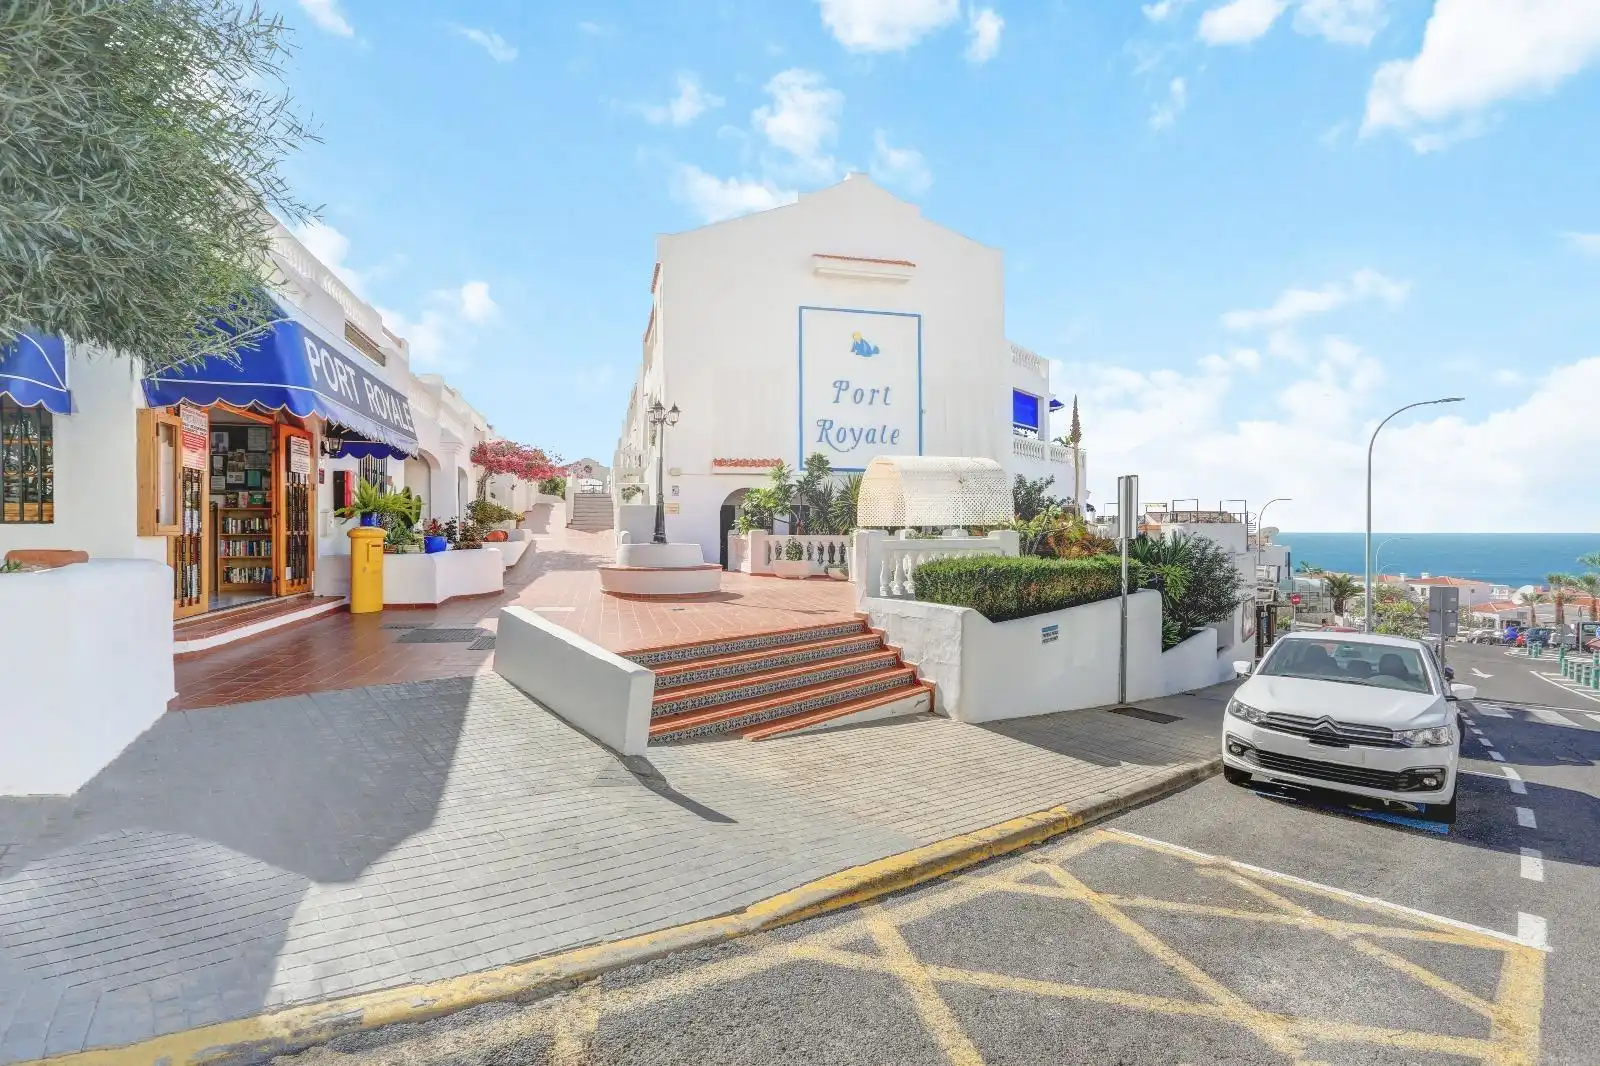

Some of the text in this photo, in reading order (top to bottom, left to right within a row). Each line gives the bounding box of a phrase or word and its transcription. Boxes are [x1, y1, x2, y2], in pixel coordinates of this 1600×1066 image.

[303, 336, 415, 433] PORT ROYALE
[832, 379, 892, 406] Port
[815, 418, 900, 453] Royale
